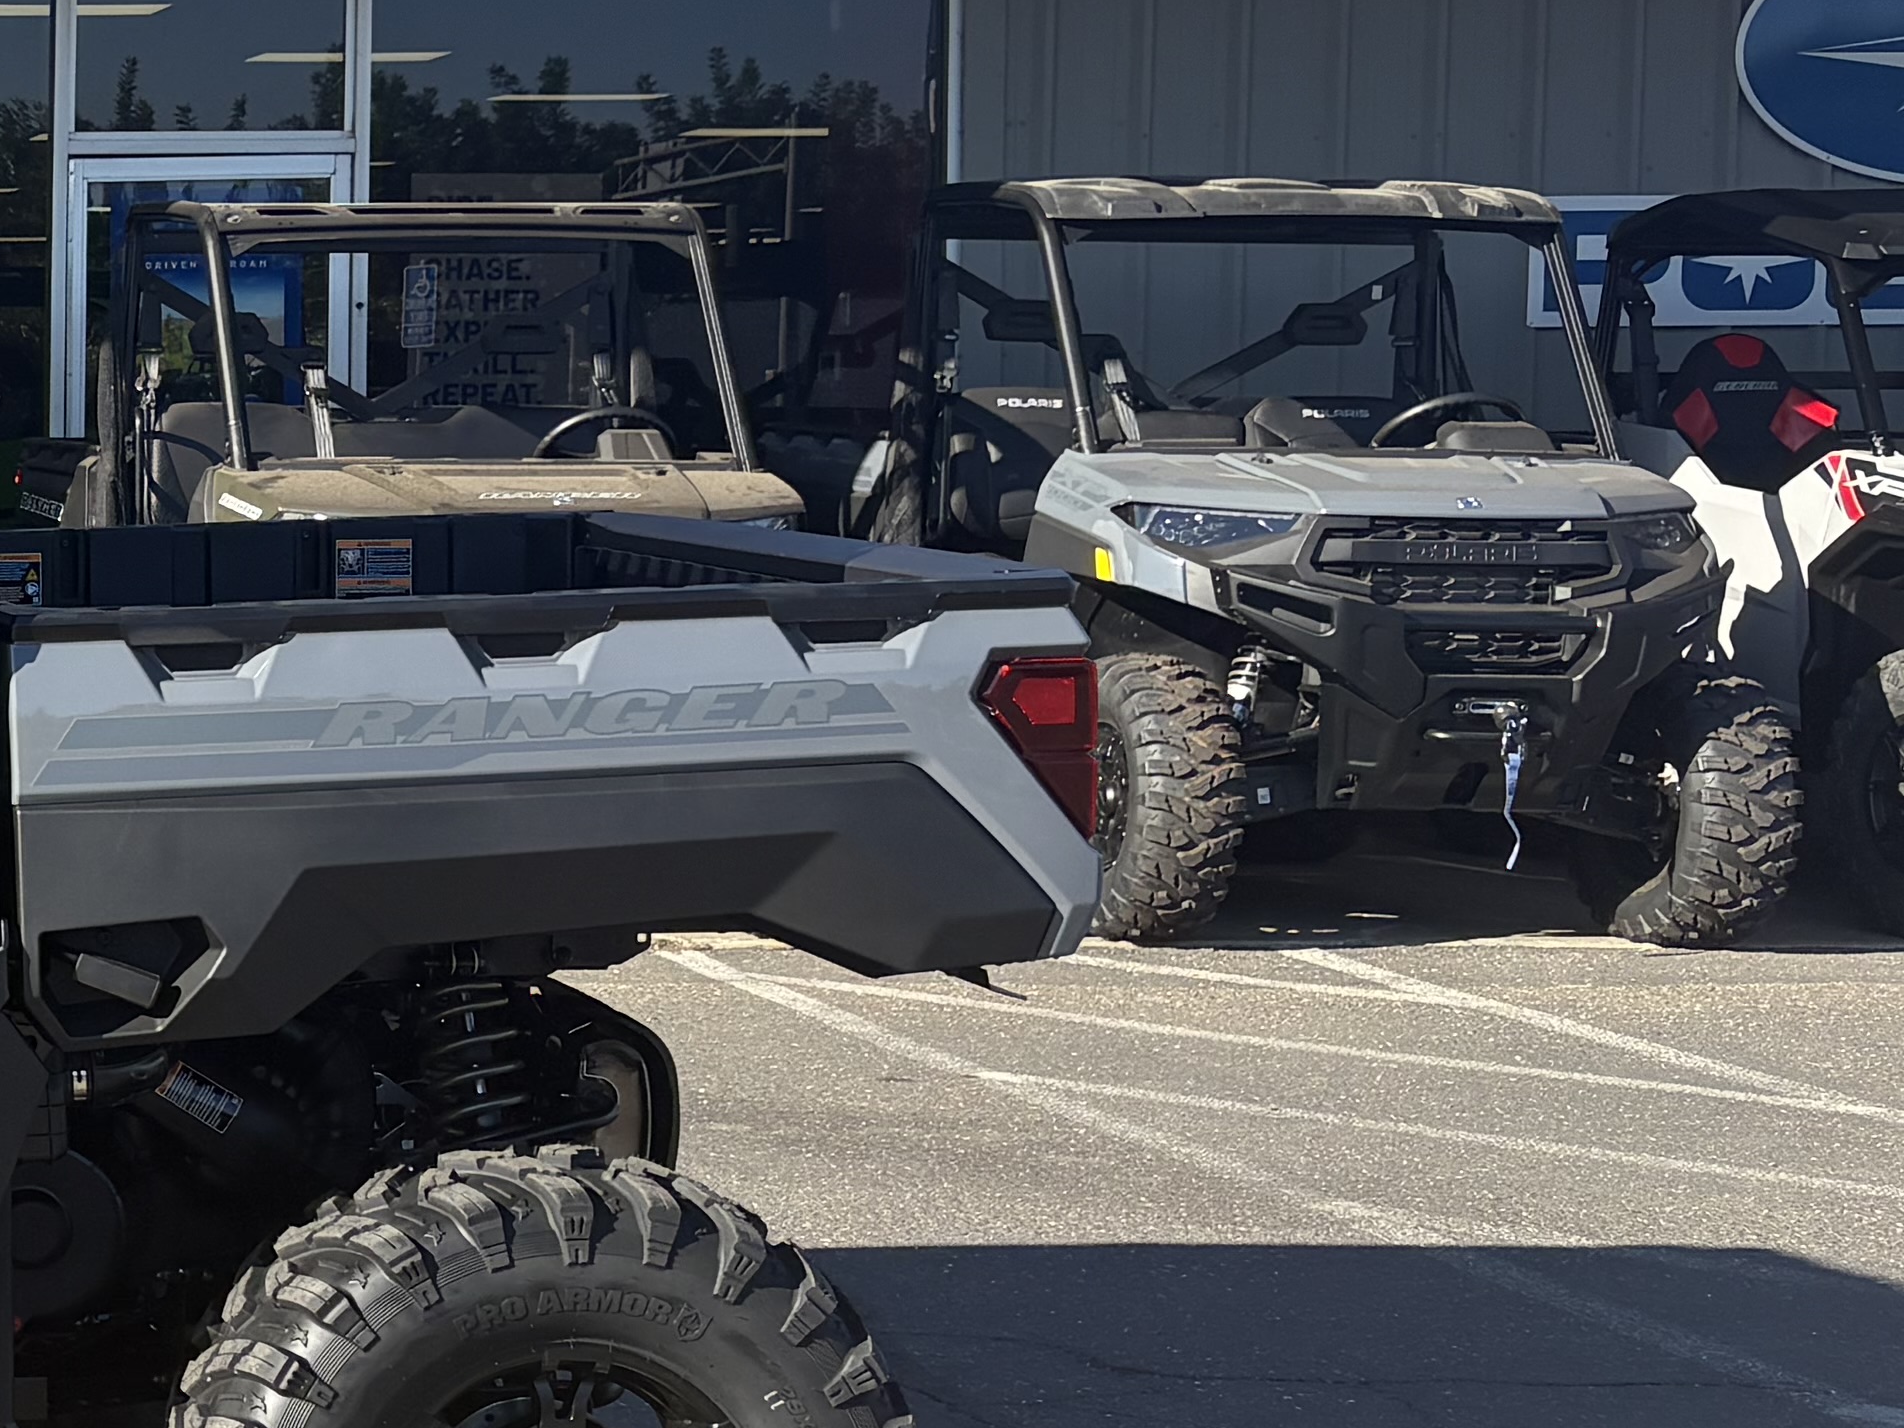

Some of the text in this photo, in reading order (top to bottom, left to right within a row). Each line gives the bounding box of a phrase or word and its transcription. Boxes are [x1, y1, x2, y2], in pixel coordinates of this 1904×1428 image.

[432, 289, 540, 313] ATHER
[996, 397, 1064, 409] POLARIS
[1301, 407, 1370, 419] POLARIS
[1403, 542, 1539, 563] POLARIS
[312, 678, 848, 748] RANGER
[452, 1285, 674, 1340] PRO ARMOR
